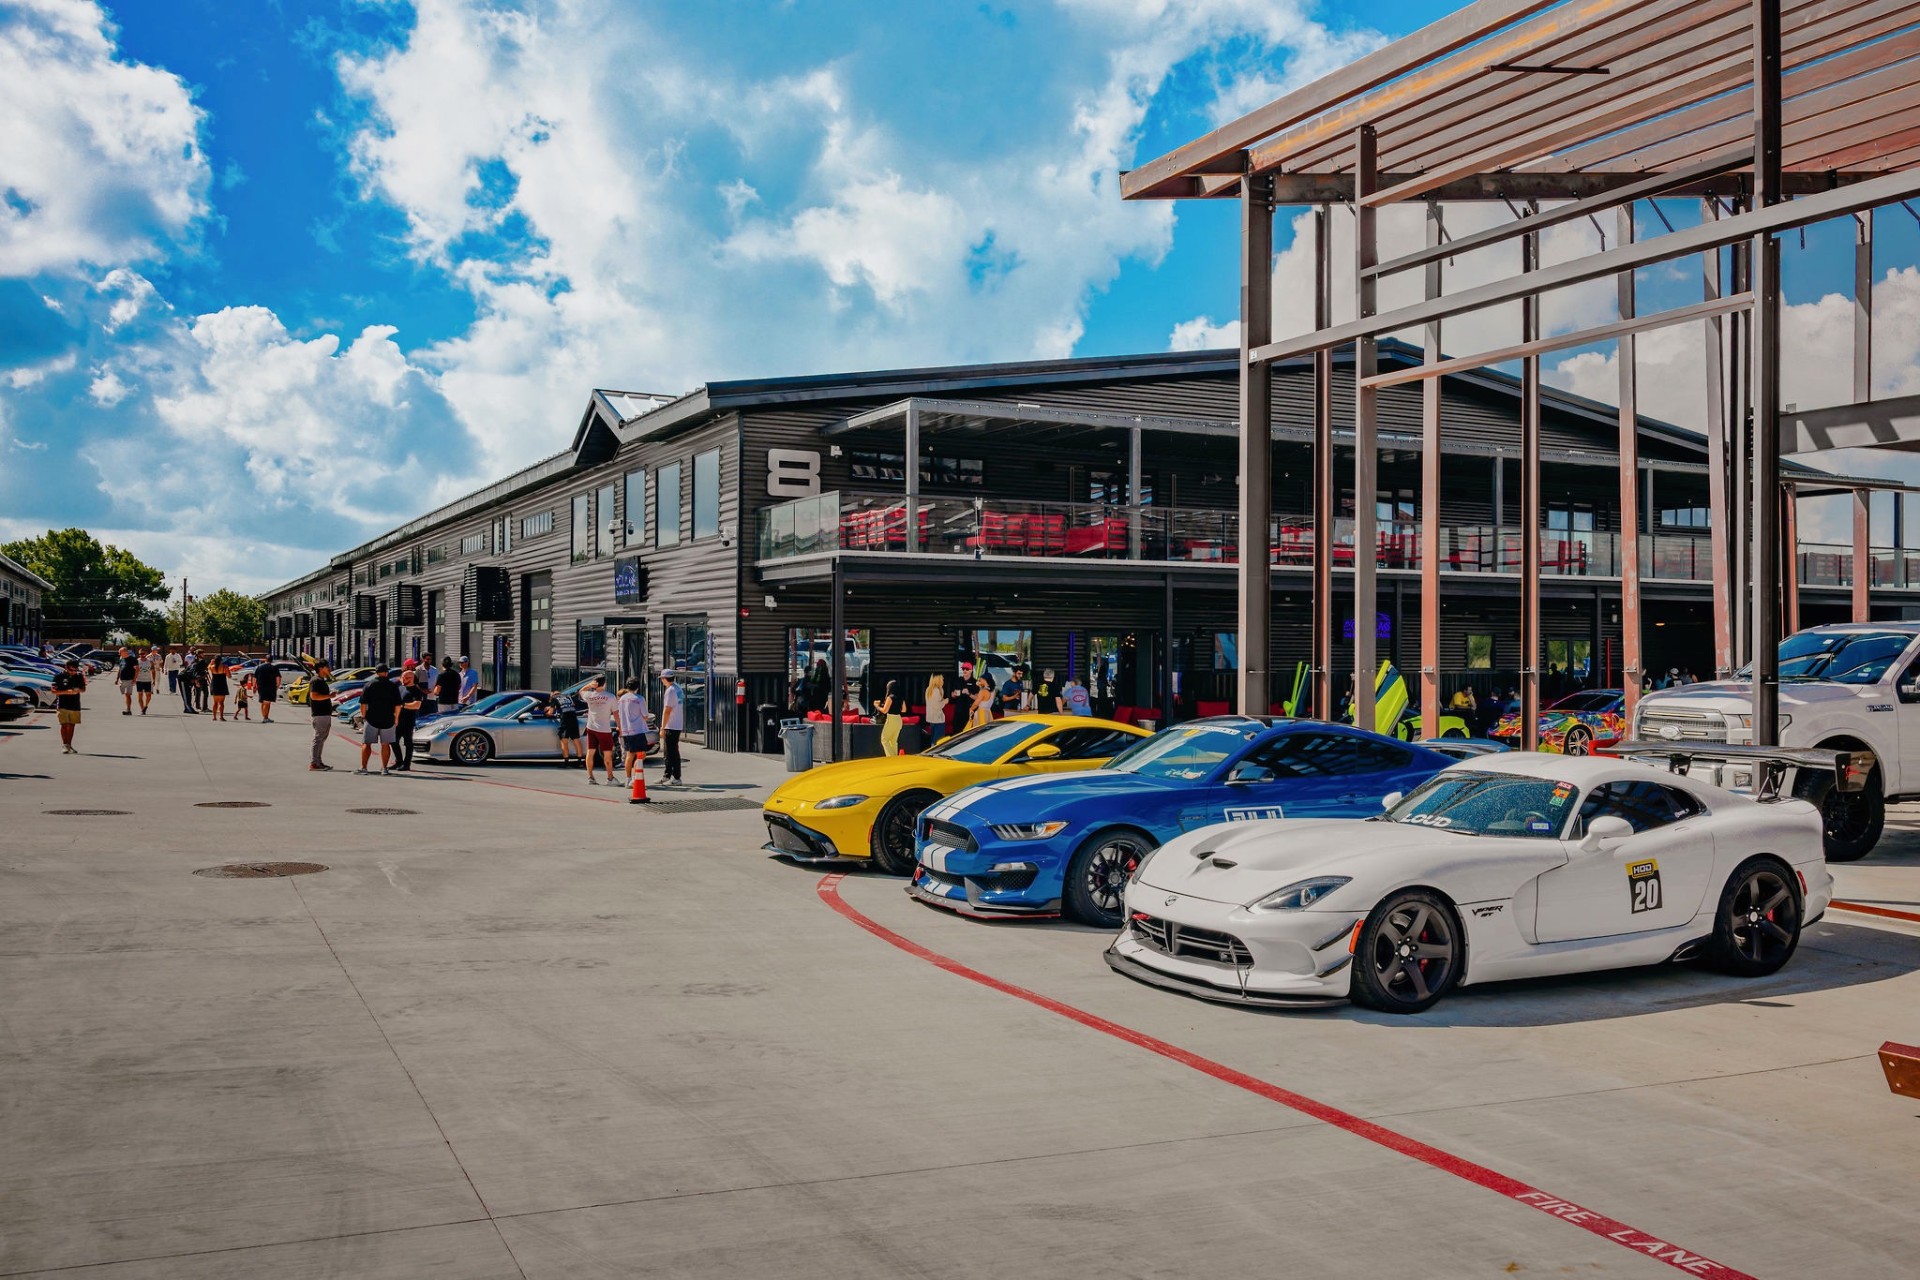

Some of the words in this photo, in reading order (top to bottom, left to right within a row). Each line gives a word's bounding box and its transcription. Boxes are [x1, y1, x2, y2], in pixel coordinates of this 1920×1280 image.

[767, 448, 821, 498] 8
[1400, 813, 1452, 827] LOUD
[1633, 878, 1659, 912] 20
[1515, 1192, 1601, 1223] FIRE
[1609, 1230, 1725, 1273] LANE
